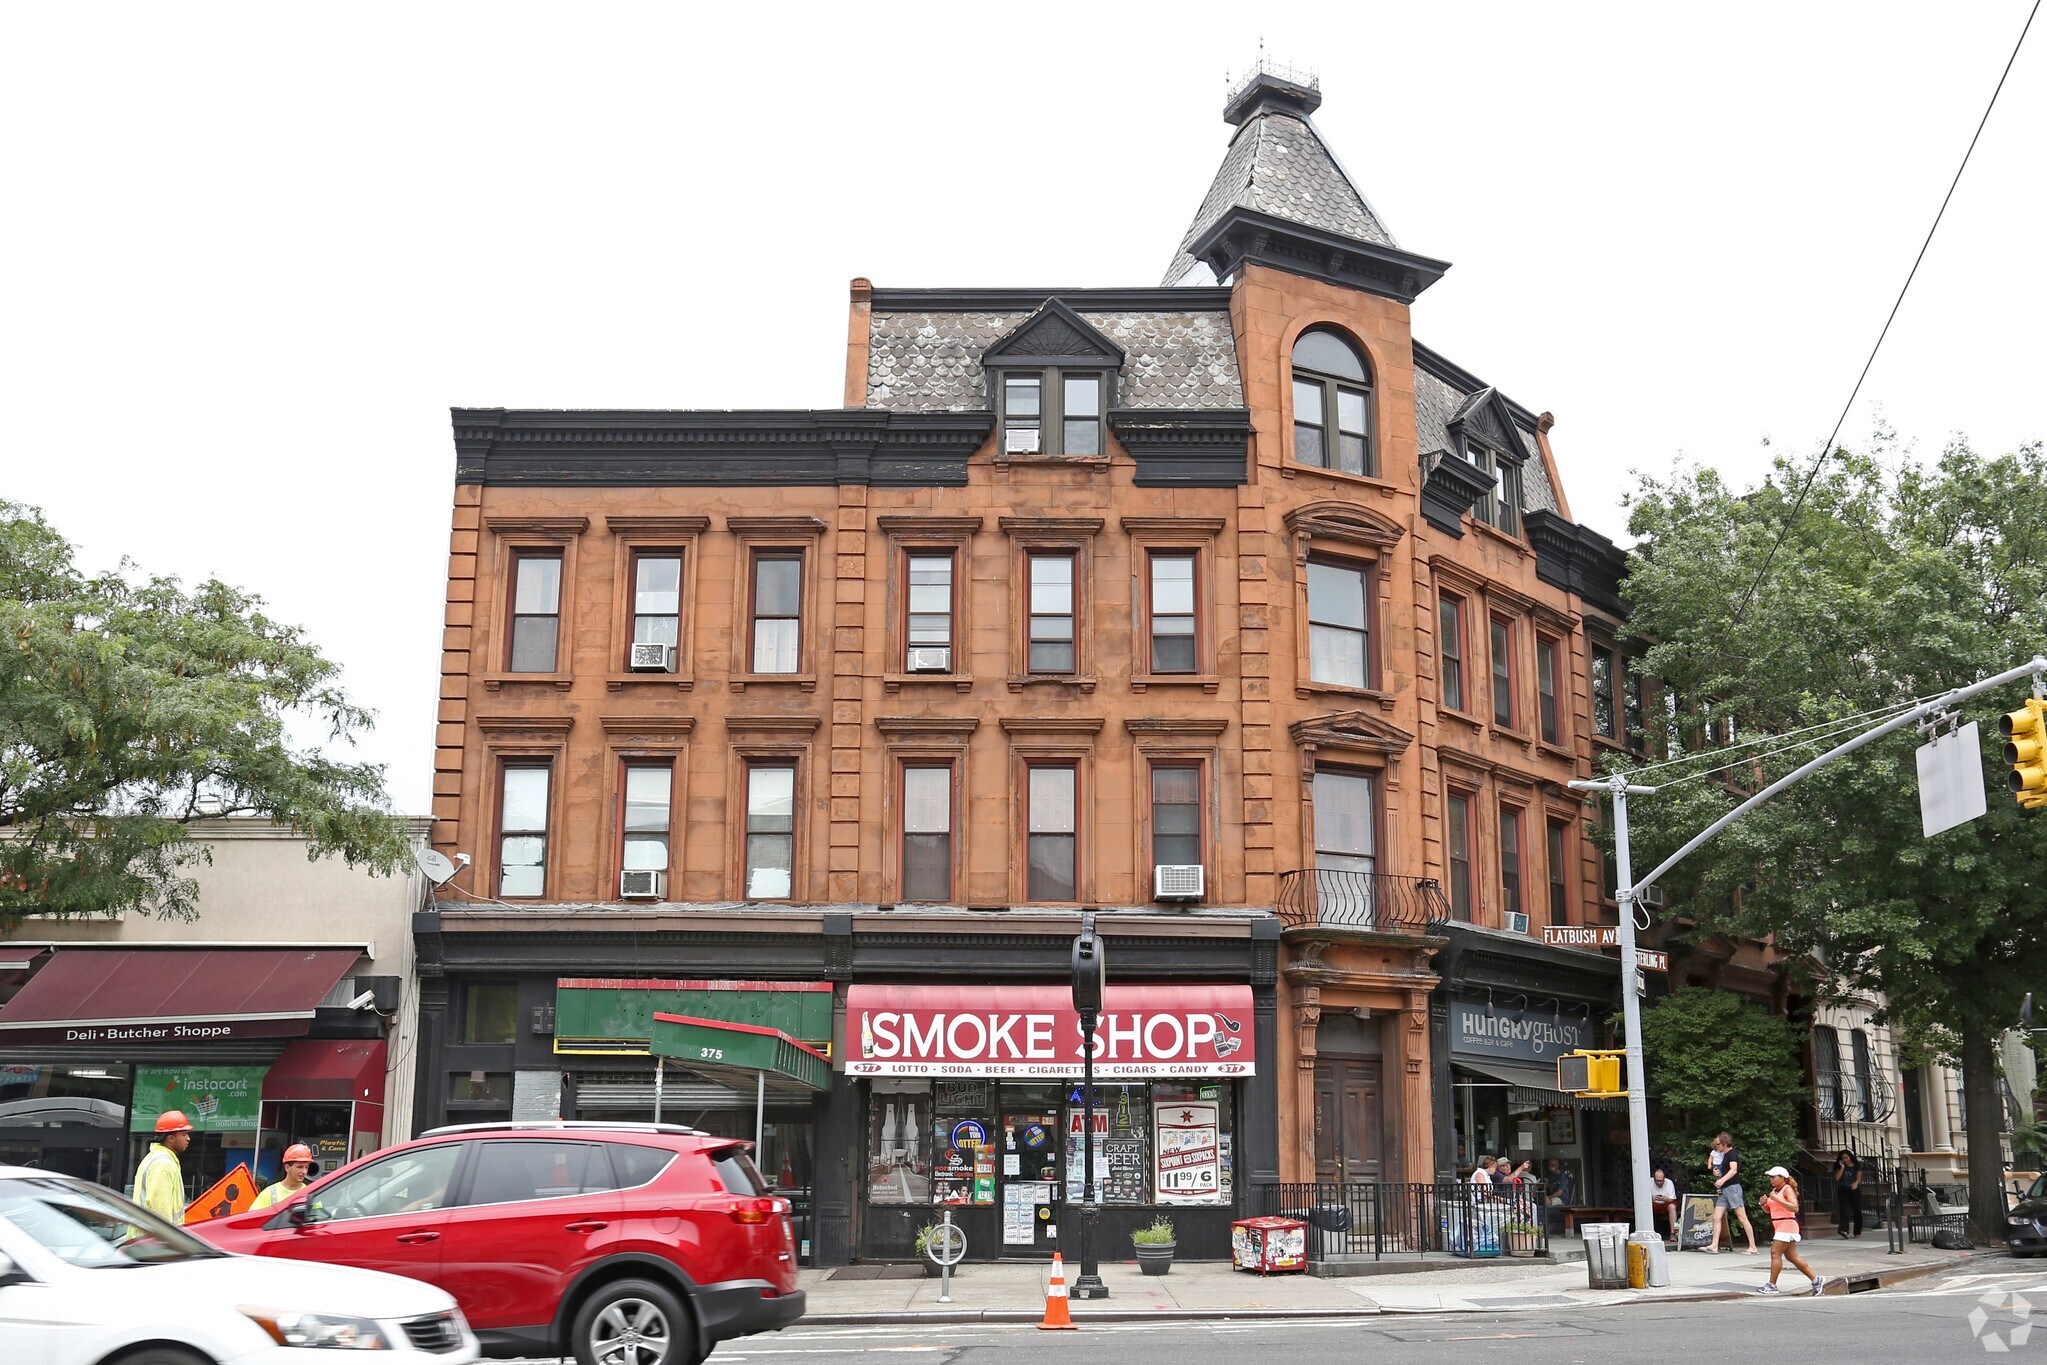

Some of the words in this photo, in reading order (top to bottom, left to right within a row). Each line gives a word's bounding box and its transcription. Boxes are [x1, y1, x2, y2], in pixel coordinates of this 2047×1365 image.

[1544, 929, 1597, 944] FLATBUSH
[1659, 954, 1667, 970] PL
[66, 1029, 97, 1041] Deli
[107, 1027, 168, 1039] Butcher
[174, 1026, 231, 1038] Shoppe
[872, 1012, 1055, 1059] SMOKE
[1075, 1013, 1217, 1060] SHOP
[701, 1047, 723, 1060] 375
[856, 1064, 879, 1072] 377
[892, 1065, 928, 1073] LOTTO
[1029, 1066, 1100, 1074] CIGARETTS
[1169, 1065, 1209, 1073] CANDY
[1220, 1064, 1243, 1072] 377
[183, 1078, 248, 1090] instacart
[946, 1082, 979, 1093] BUD
[938, 1093, 985, 1106] LIGHT
[1106, 1144, 1139, 1152] CRAFT
[1163, 1146, 1181, 1155] NEW
[1105, 1153, 1141, 1165] BEER
[1200, 1171, 1212, 1182] 6
